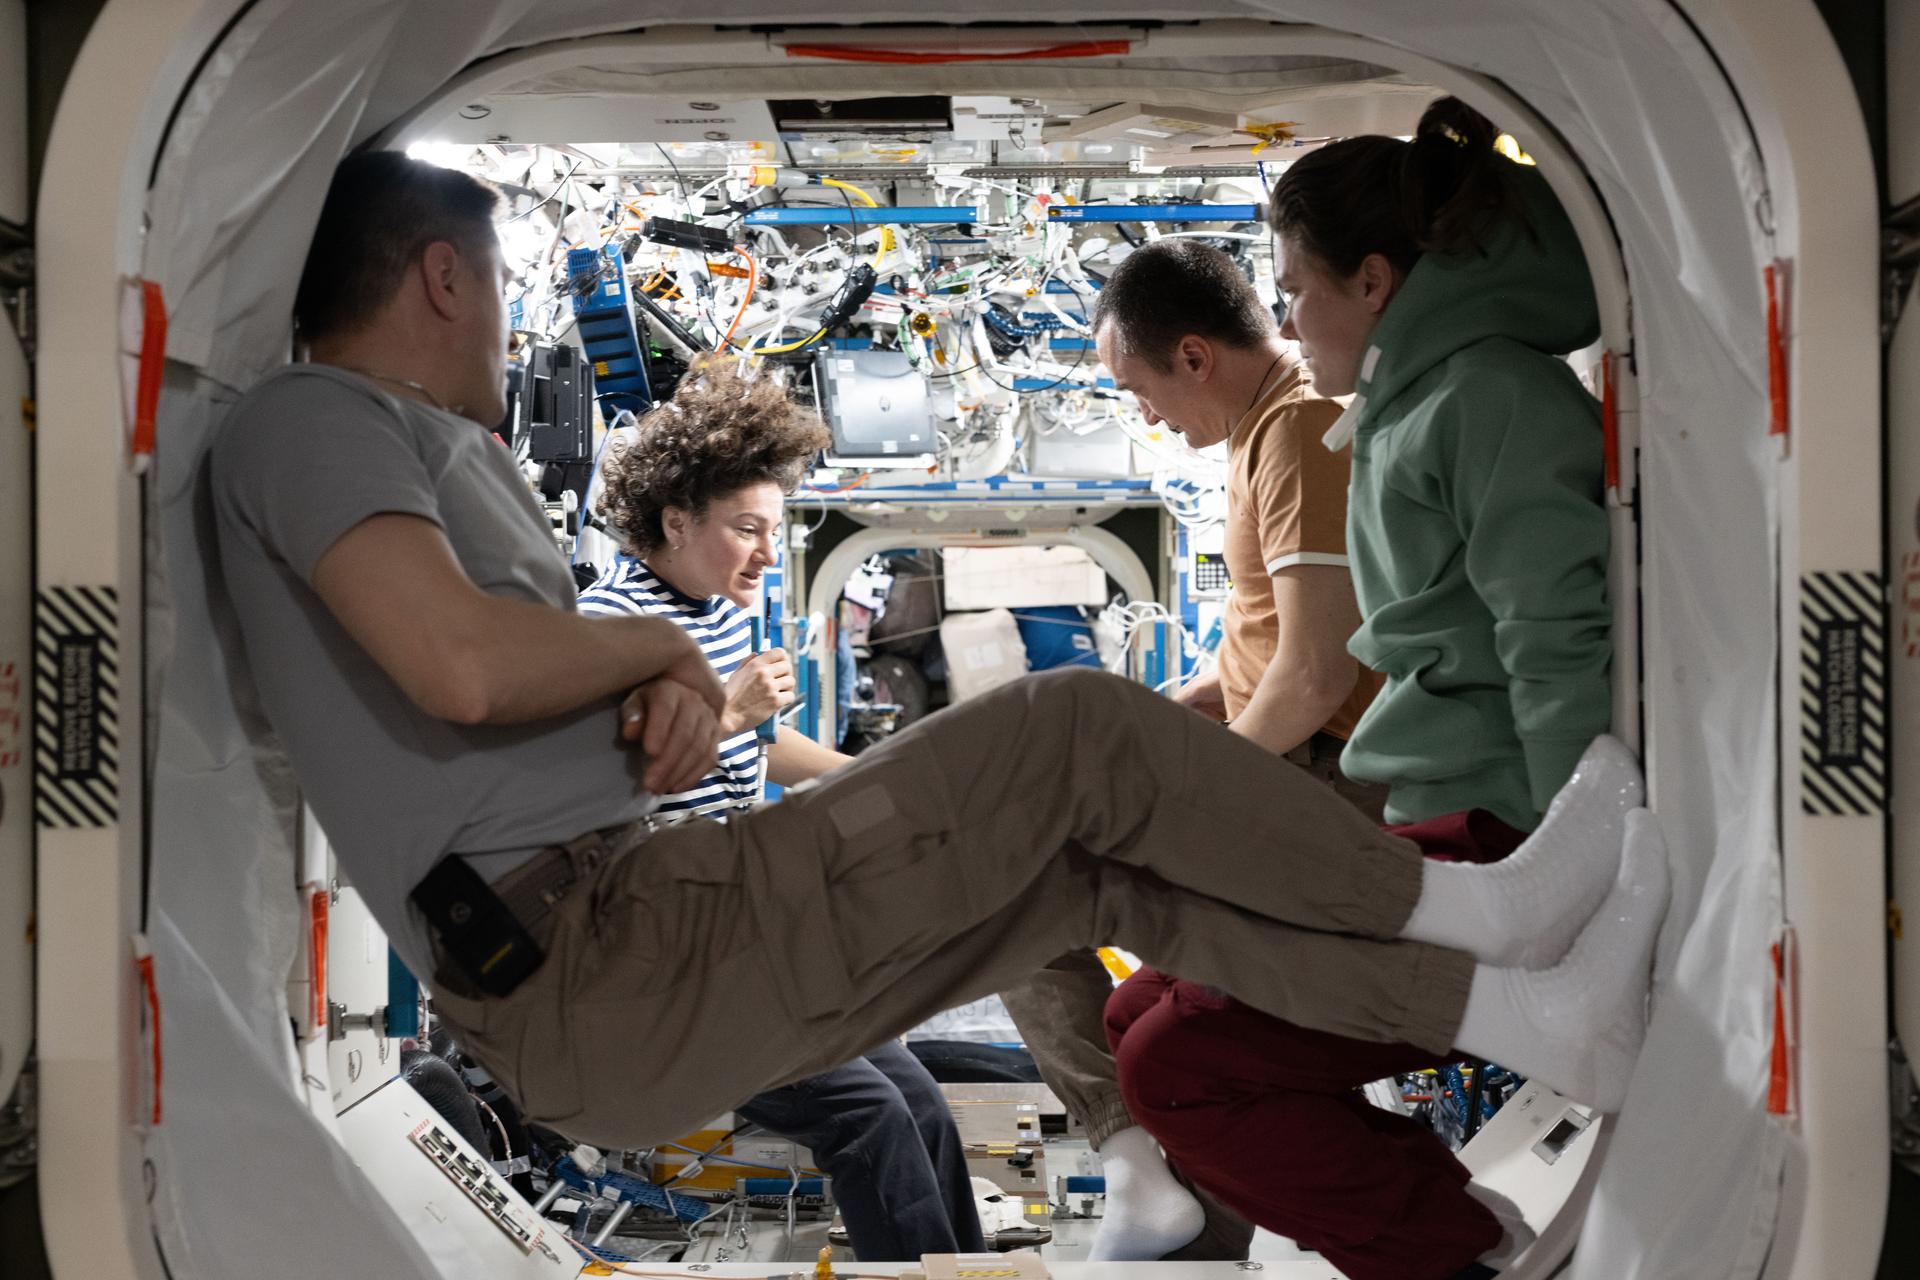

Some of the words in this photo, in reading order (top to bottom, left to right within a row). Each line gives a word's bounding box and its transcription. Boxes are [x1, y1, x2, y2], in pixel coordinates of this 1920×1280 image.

[63, 645, 78, 704] BEFORE
[78, 646, 92, 716] CLOSURE
[1827, 629, 1841, 682] HATCH
[1842, 629, 1857, 693] REMOVE
[63, 709, 78, 771] REMOVE
[78, 719, 92, 771] HATCH
[1827, 685, 1841, 755] CLOSURE
[1842, 697, 1857, 756] BEFORE
[800, 1195, 825, 1204] Tank
